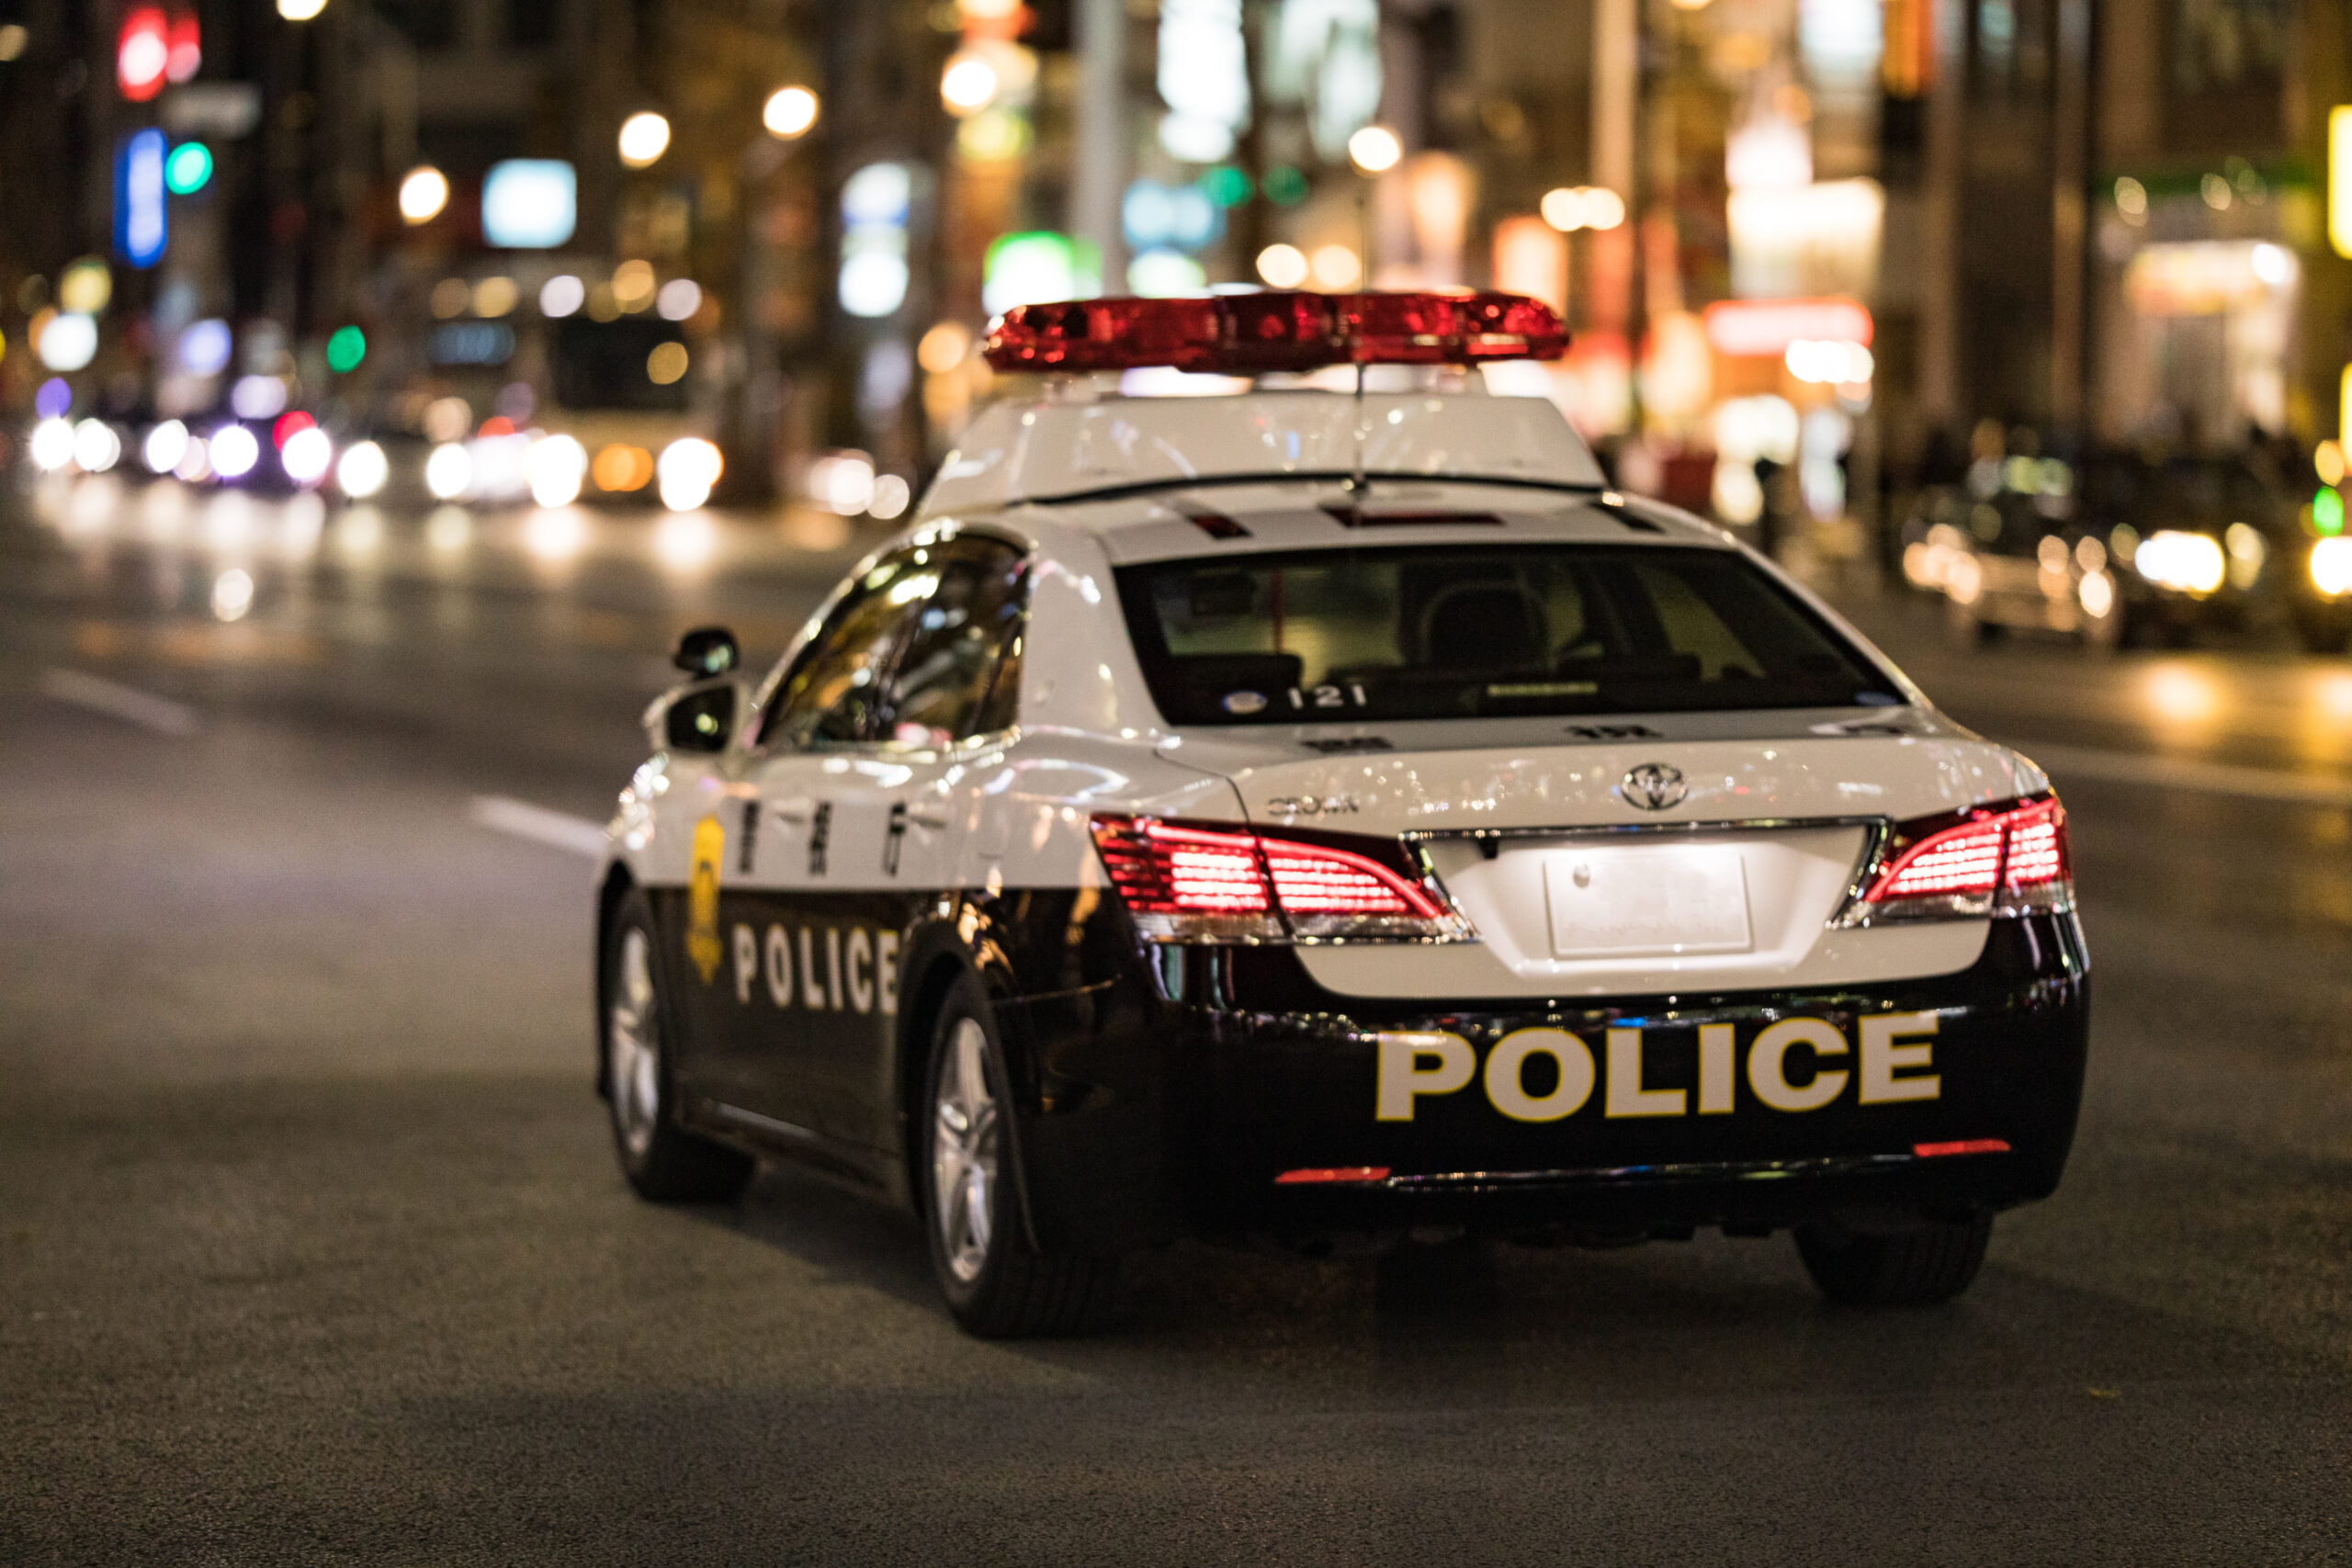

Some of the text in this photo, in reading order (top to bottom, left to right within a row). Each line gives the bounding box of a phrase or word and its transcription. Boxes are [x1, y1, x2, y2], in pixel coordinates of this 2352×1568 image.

[1288, 684, 1366, 709] 121
[732, 923, 899, 1014] POLICE
[1376, 1013, 1941, 1122] POLICE
